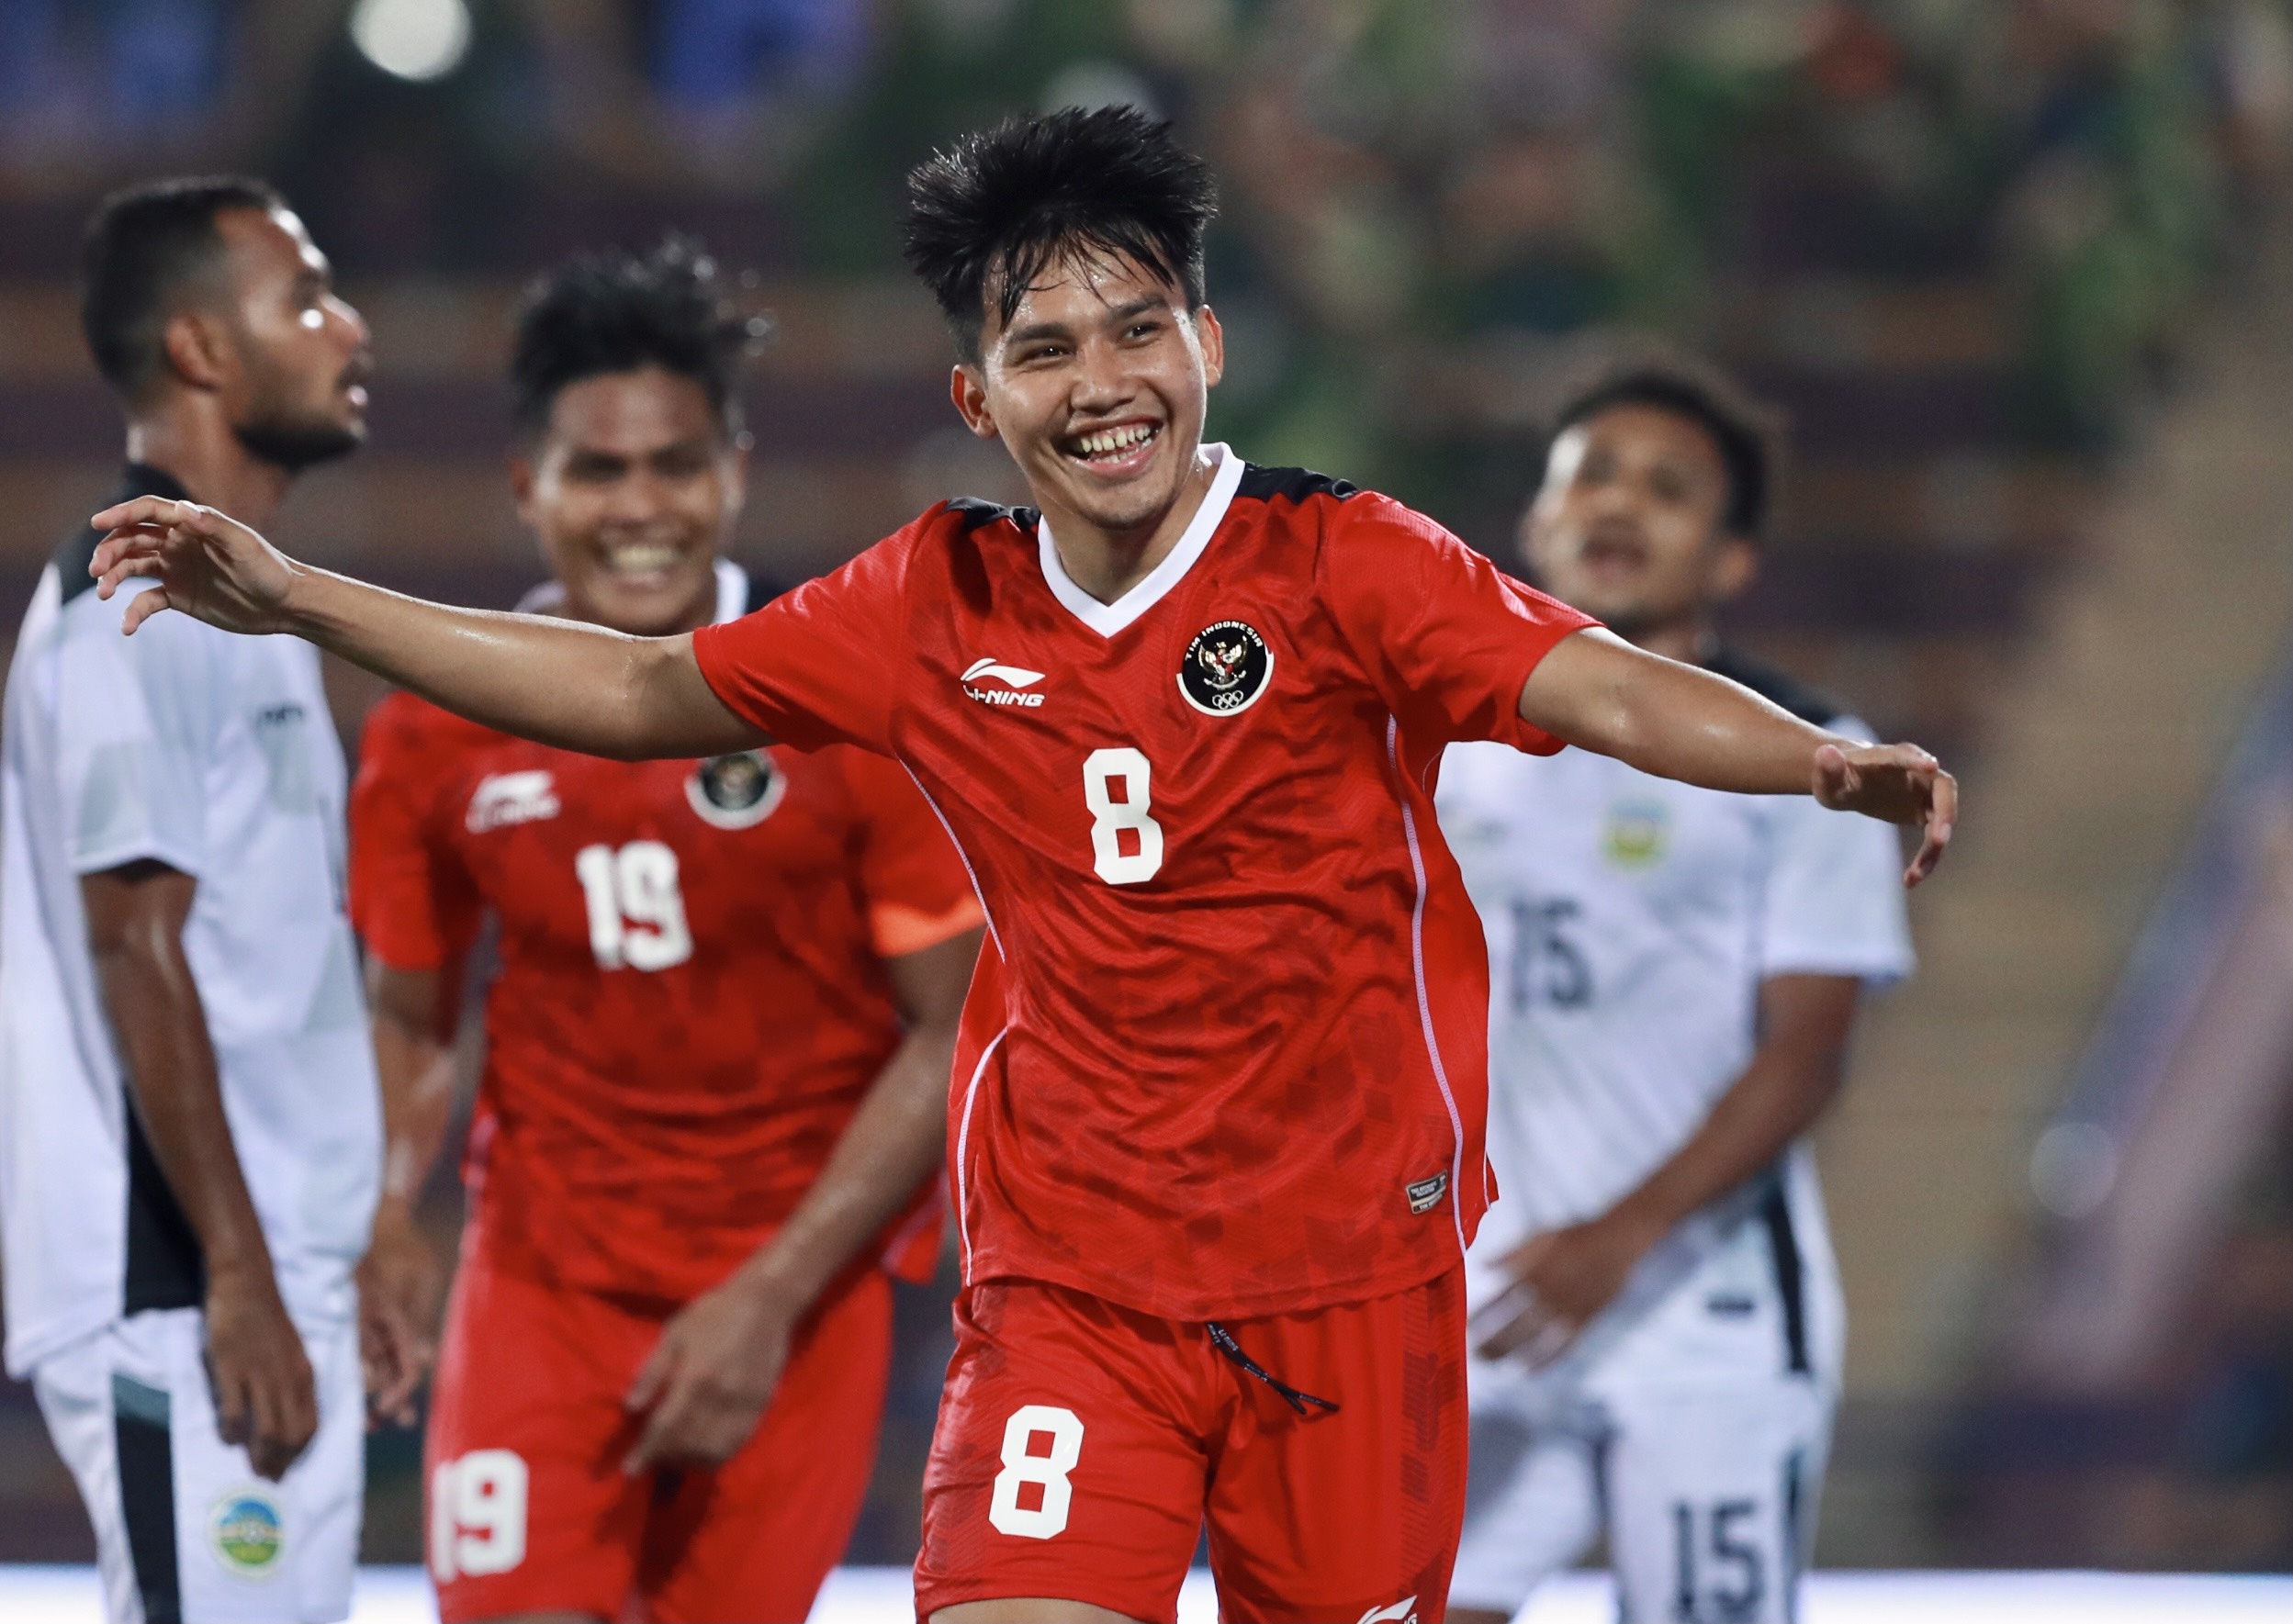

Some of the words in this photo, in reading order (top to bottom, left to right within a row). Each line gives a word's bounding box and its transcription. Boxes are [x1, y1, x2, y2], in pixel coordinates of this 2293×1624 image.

[1185, 637, 1201, 661] TIM
[1201, 621, 1264, 647] INDONESIA
[1083, 747, 1163, 885] 8
[575, 841, 693, 971] 19
[1509, 893, 1594, 1015] 15
[432, 1448, 530, 1584] 19
[988, 1405, 1085, 1540] 8
[1674, 1499, 1764, 1619] 15
